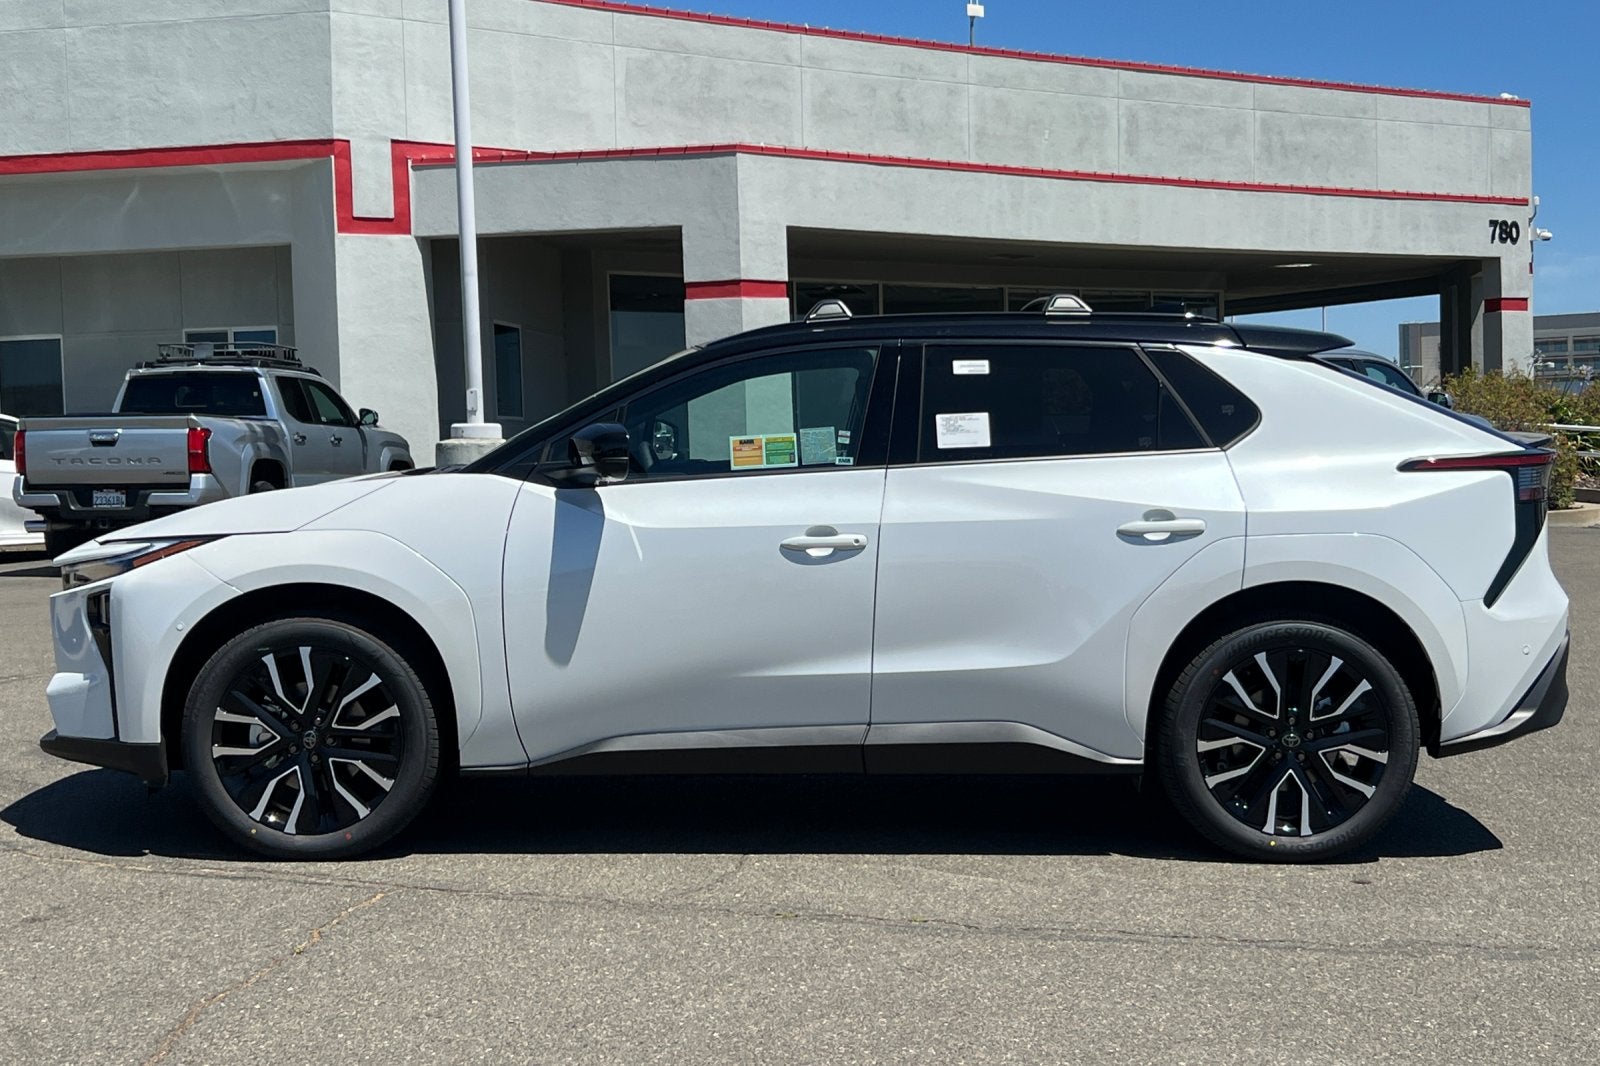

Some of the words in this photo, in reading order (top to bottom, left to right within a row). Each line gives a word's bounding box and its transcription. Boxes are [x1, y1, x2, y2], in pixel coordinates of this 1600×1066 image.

[1489, 219, 1520, 245] 780
[51, 456, 162, 465] TACOMA
[1224, 627, 1334, 657] BRIDGESTONE
